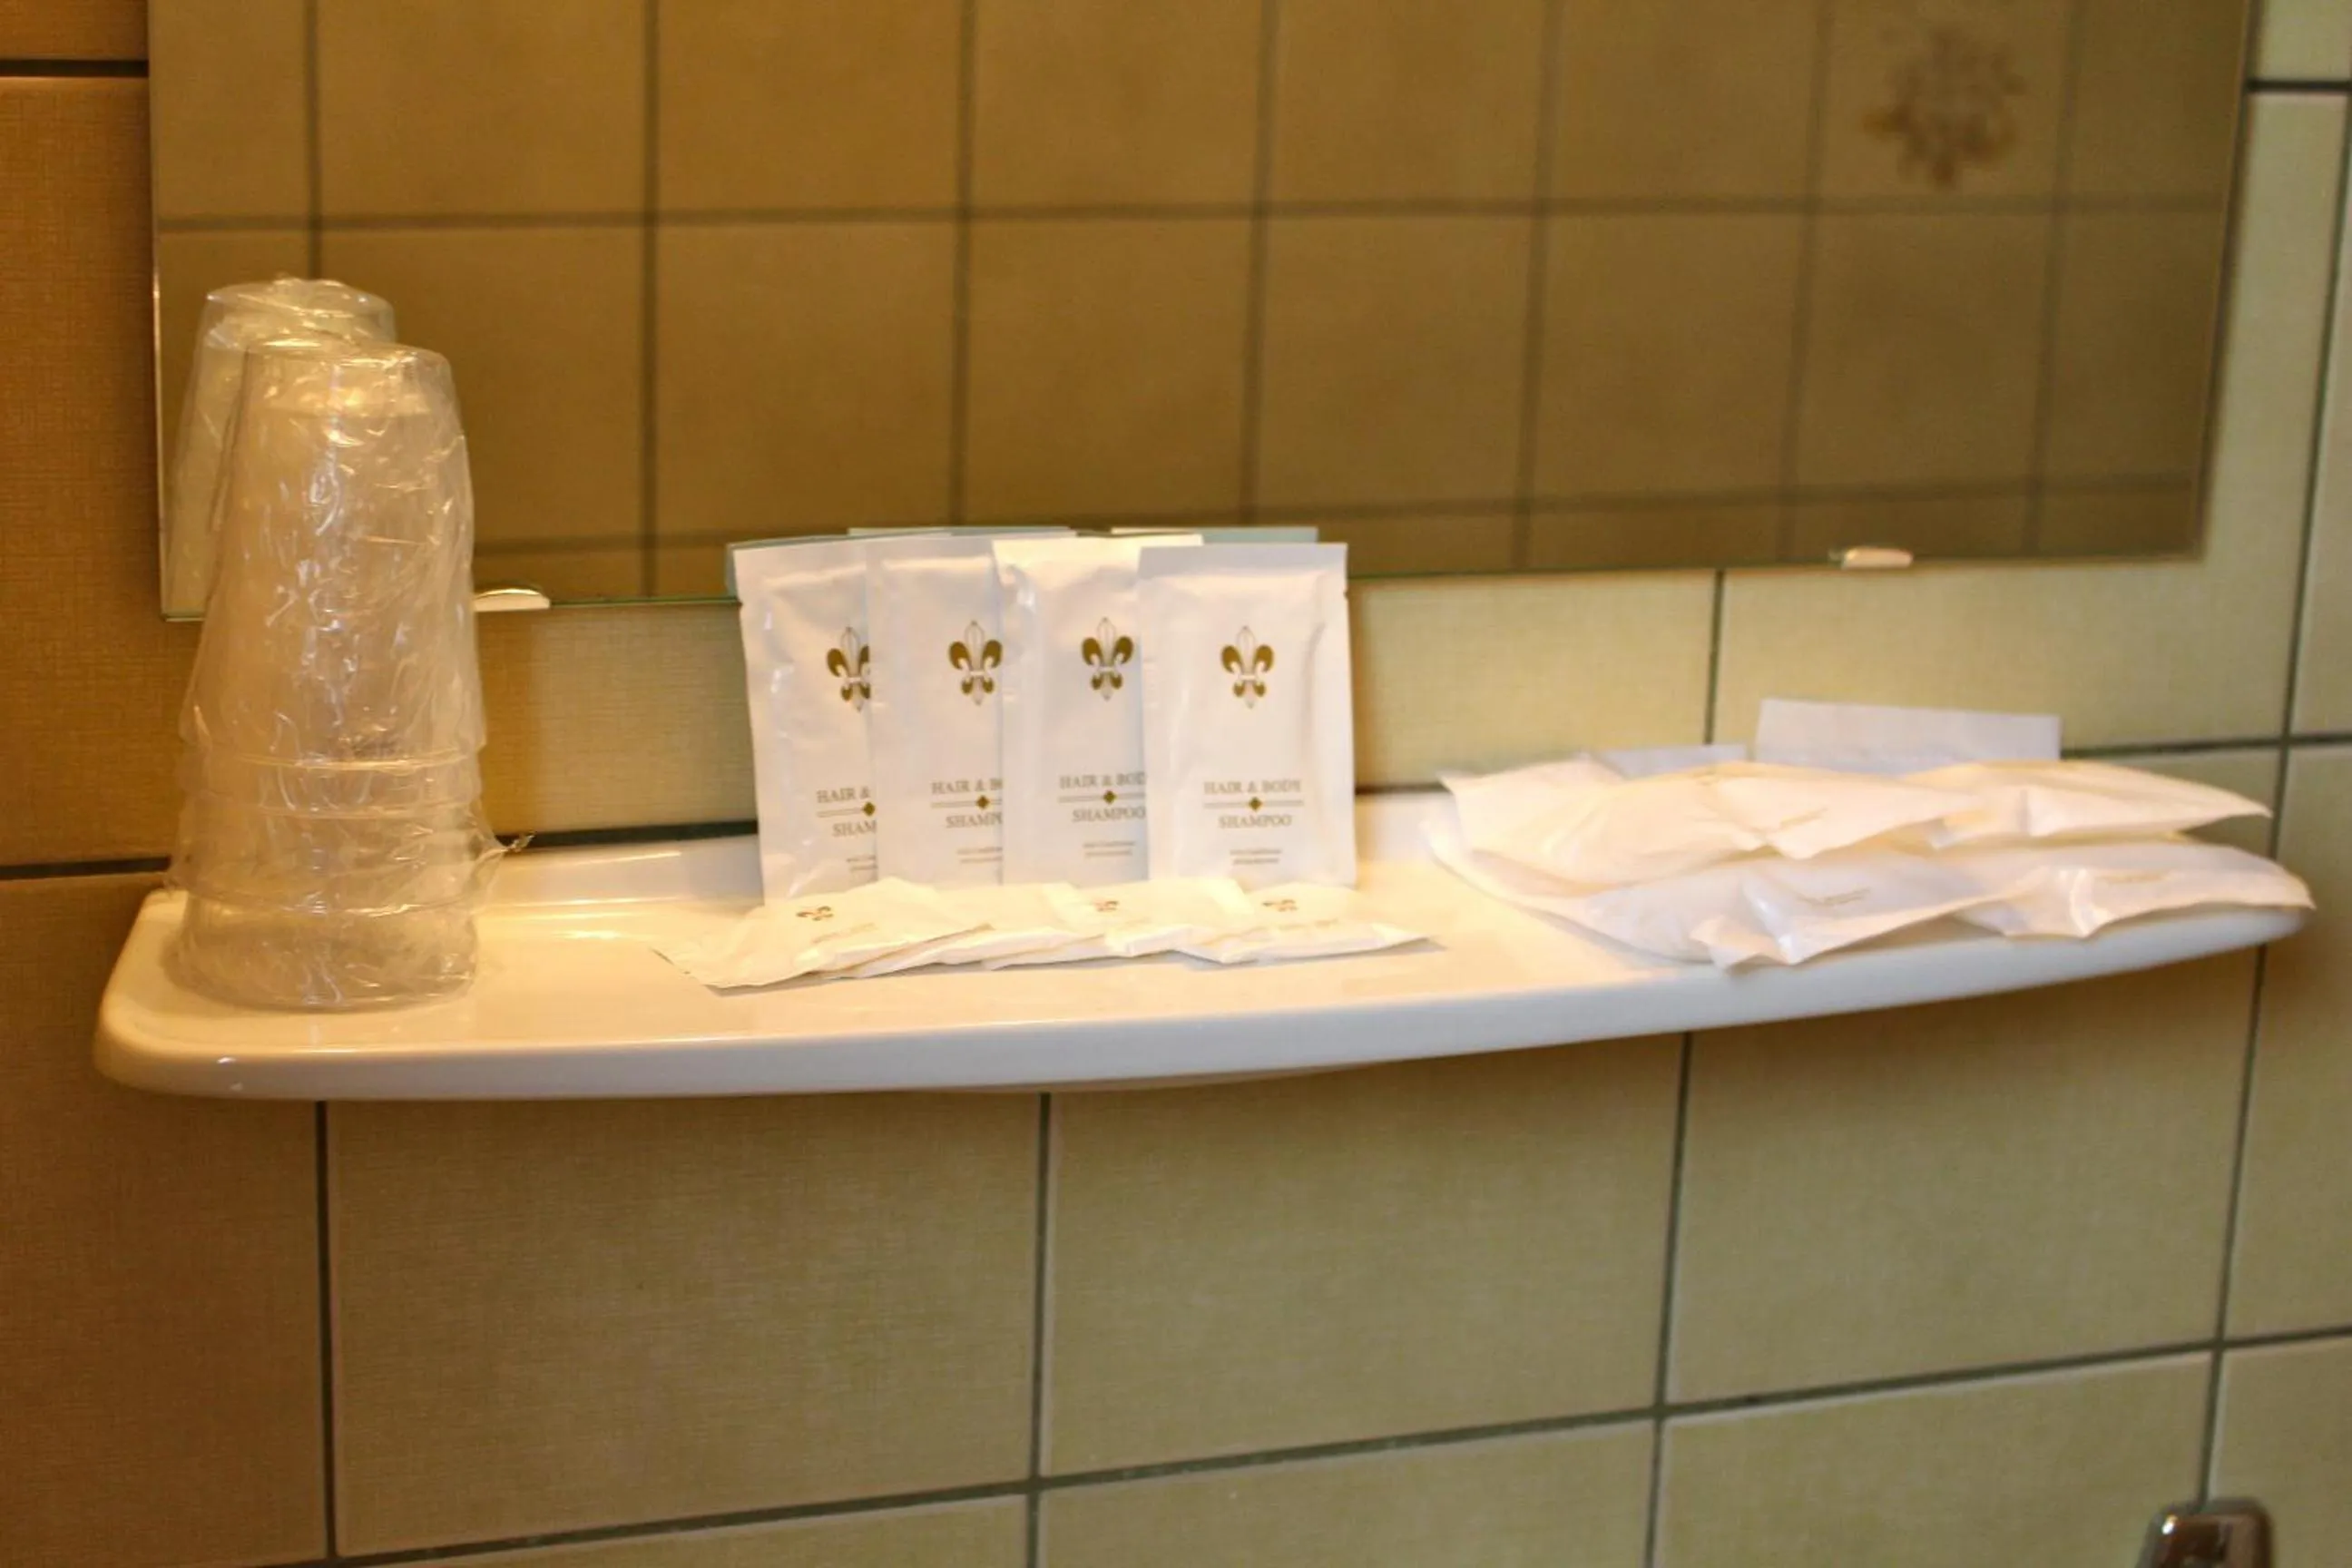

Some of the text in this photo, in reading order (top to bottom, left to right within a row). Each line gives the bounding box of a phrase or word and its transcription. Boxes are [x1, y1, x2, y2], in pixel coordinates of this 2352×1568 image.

[931, 780, 970, 795] HAIR
[975, 778, 986, 792] &
[1059, 774, 1097, 789] HAIR
[1102, 774, 1112, 787] &
[1203, 779, 1301, 795] HAIR & BODY
[816, 785, 871, 803] HAIR &
[1072, 806, 1147, 822] SHAMPOO
[1219, 814, 1293, 829] SHAMPOO
